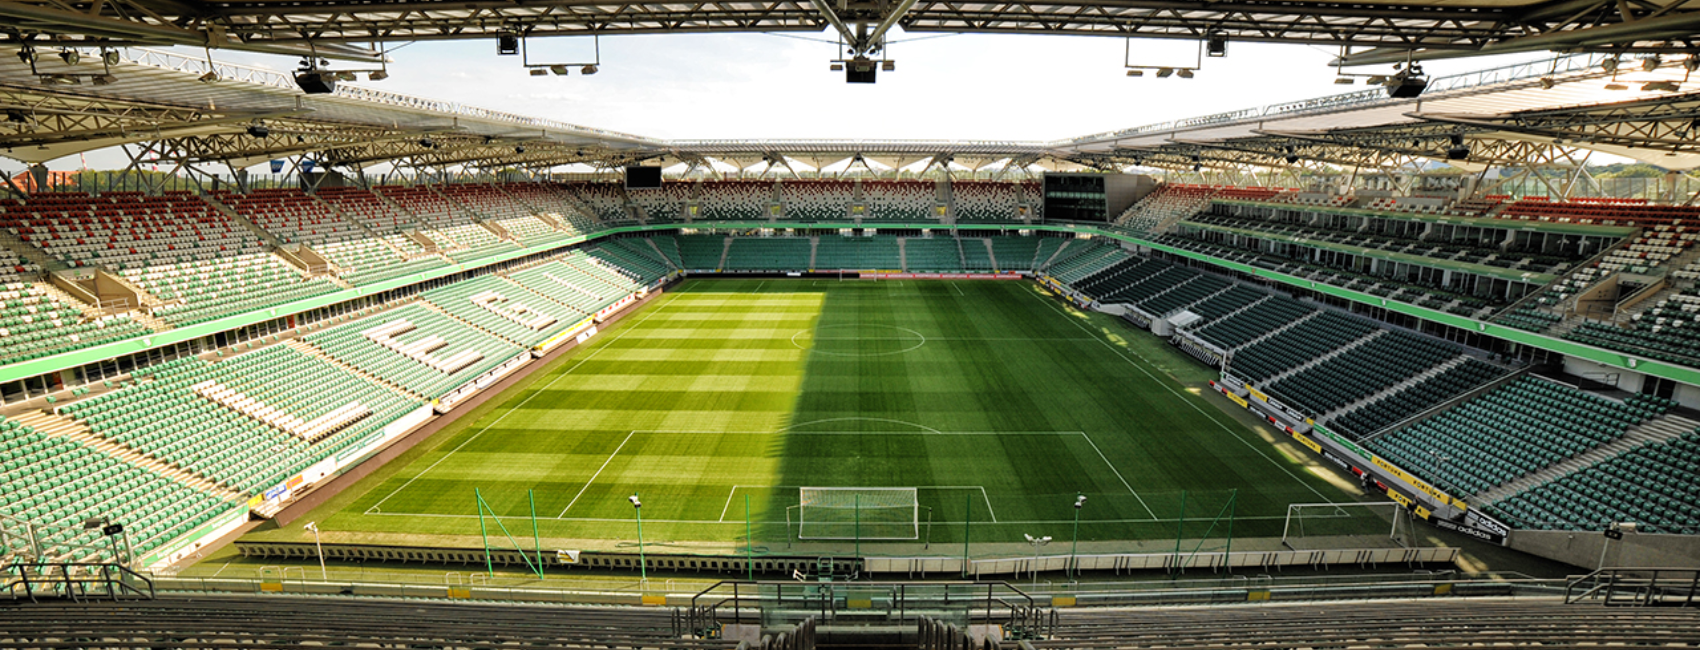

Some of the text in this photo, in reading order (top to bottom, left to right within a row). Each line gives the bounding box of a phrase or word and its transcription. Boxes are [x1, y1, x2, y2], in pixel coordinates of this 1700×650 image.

[1376, 459, 1402, 477] FORTUNA
[1457, 524, 1492, 541] adidas
[1478, 516, 1507, 537] adidas
